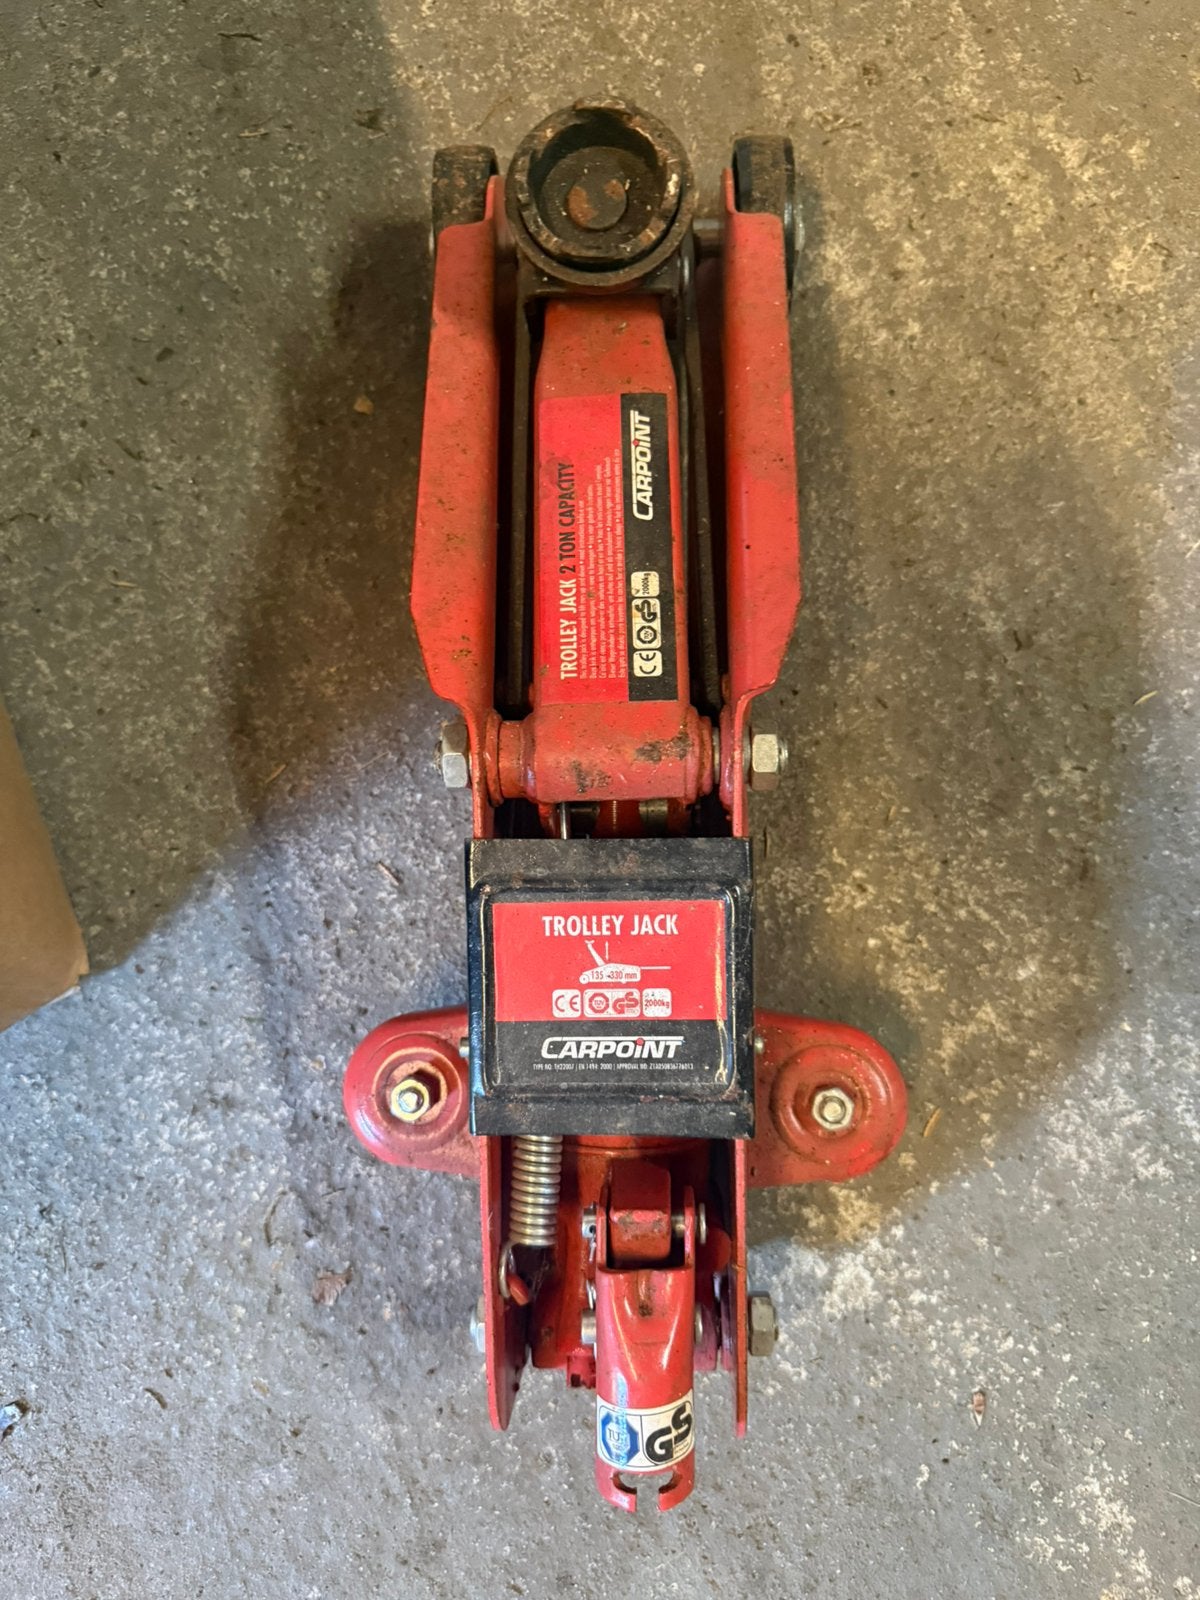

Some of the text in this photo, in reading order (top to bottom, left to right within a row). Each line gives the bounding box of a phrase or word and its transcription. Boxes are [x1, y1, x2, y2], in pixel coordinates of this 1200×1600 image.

[557, 462, 578, 680] TROLLEY JACK 2 TON CAPACITY
[642, 572, 651, 595] 2000kg
[542, 914, 679, 937] TROLLEY JACK
[591, 970, 604, 980] 135
[625, 972, 638, 980] mm
[644, 998, 670, 1009] 2000kg
[646, 1404, 692, 1463] GS
